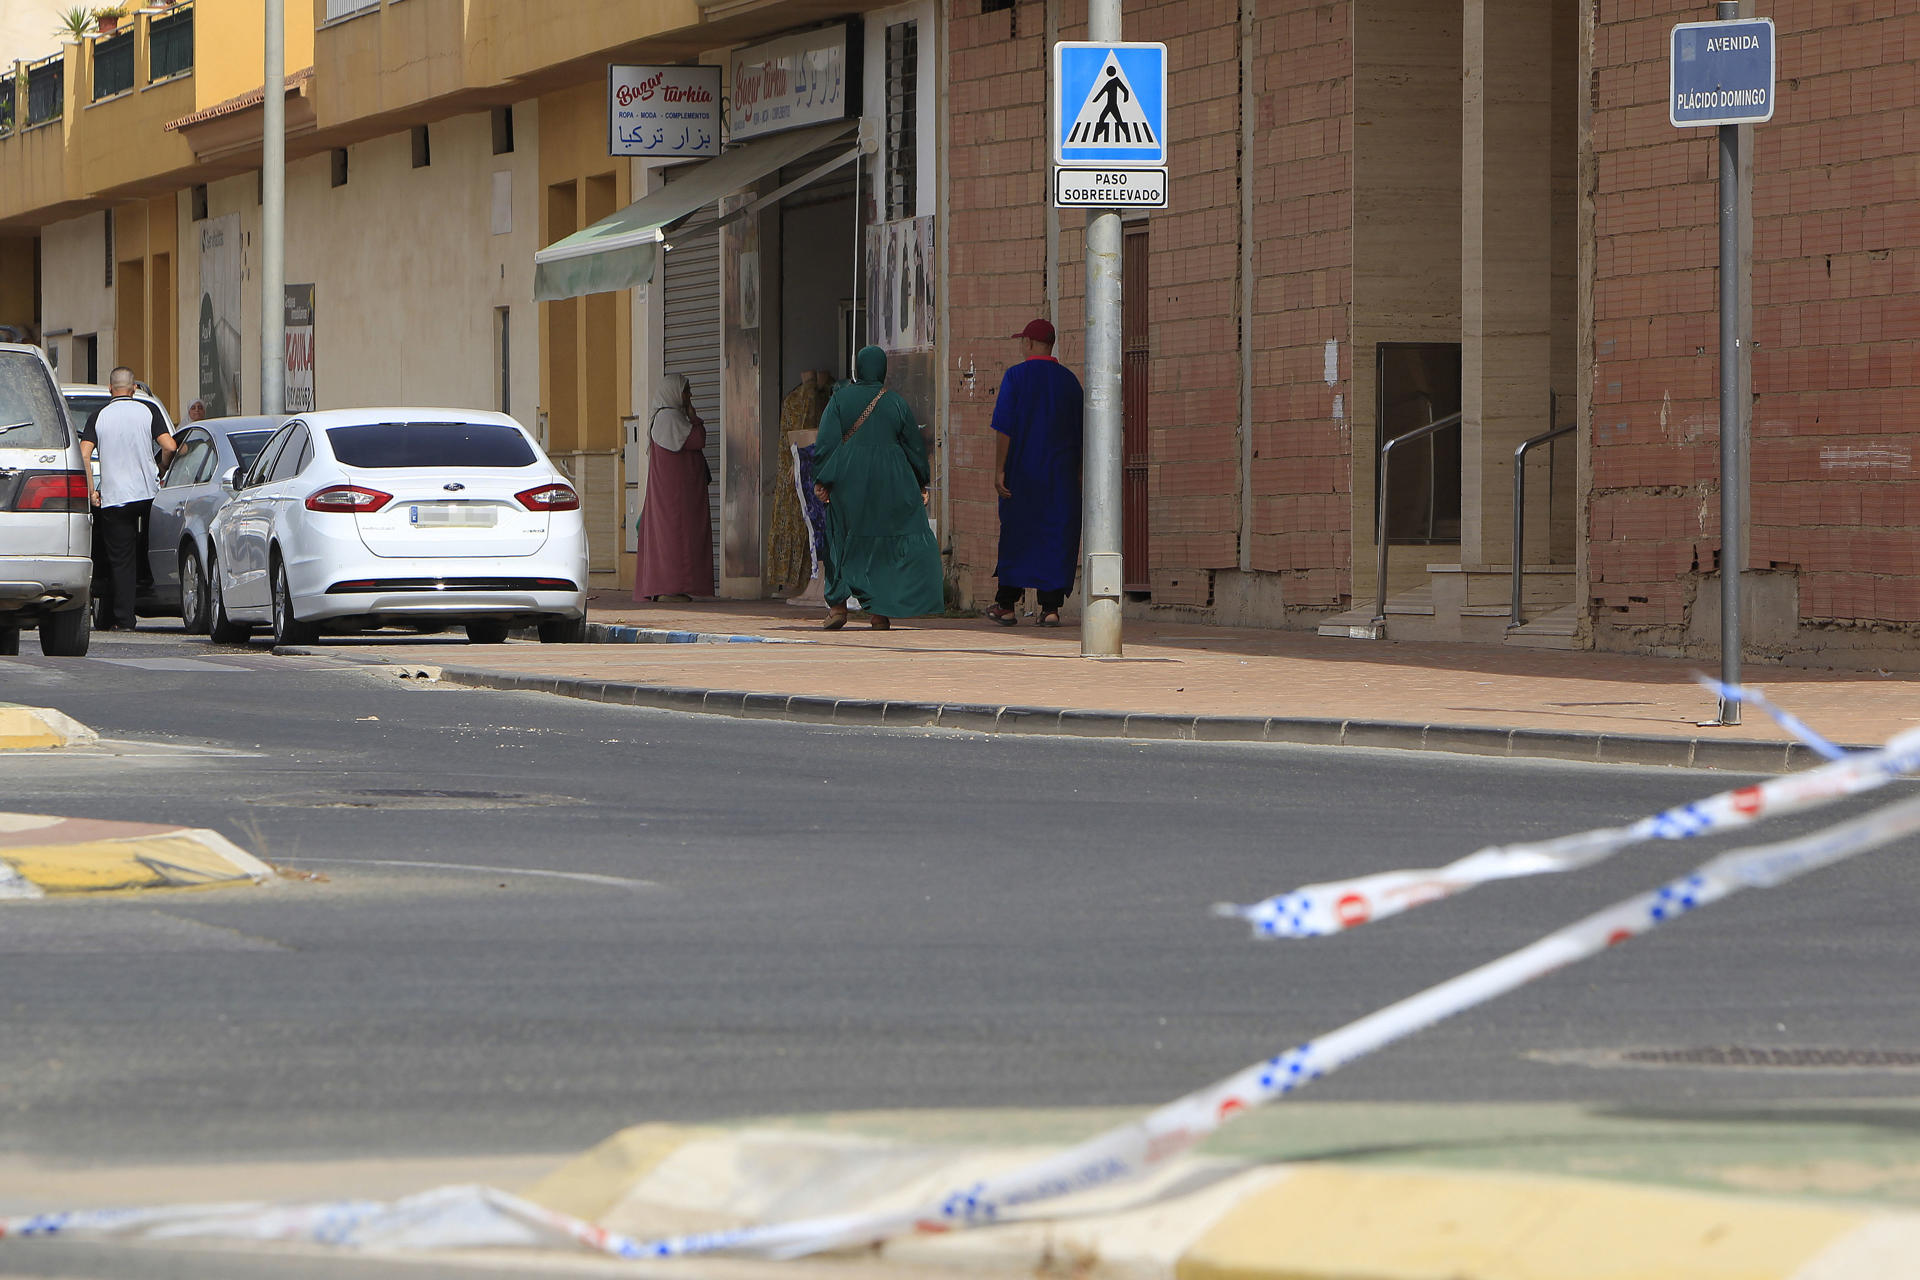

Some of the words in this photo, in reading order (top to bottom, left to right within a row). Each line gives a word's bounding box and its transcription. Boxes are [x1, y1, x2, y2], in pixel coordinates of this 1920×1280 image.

[1706, 35, 1760, 52] AVENIDA
[616, 72, 664, 107] Bazar
[1677, 88, 1718, 110] PLÁCIDO
[1720, 88, 1766, 107] DOMINGO
[618, 111, 634, 119] ROPA
[640, 111, 657, 119] MODA
[619, 125, 664, 149] تركيا
[672, 126, 711, 150] بزار
[1095, 173, 1128, 185] PASO
[1064, 189, 1159, 201] SOBREELEVADO
